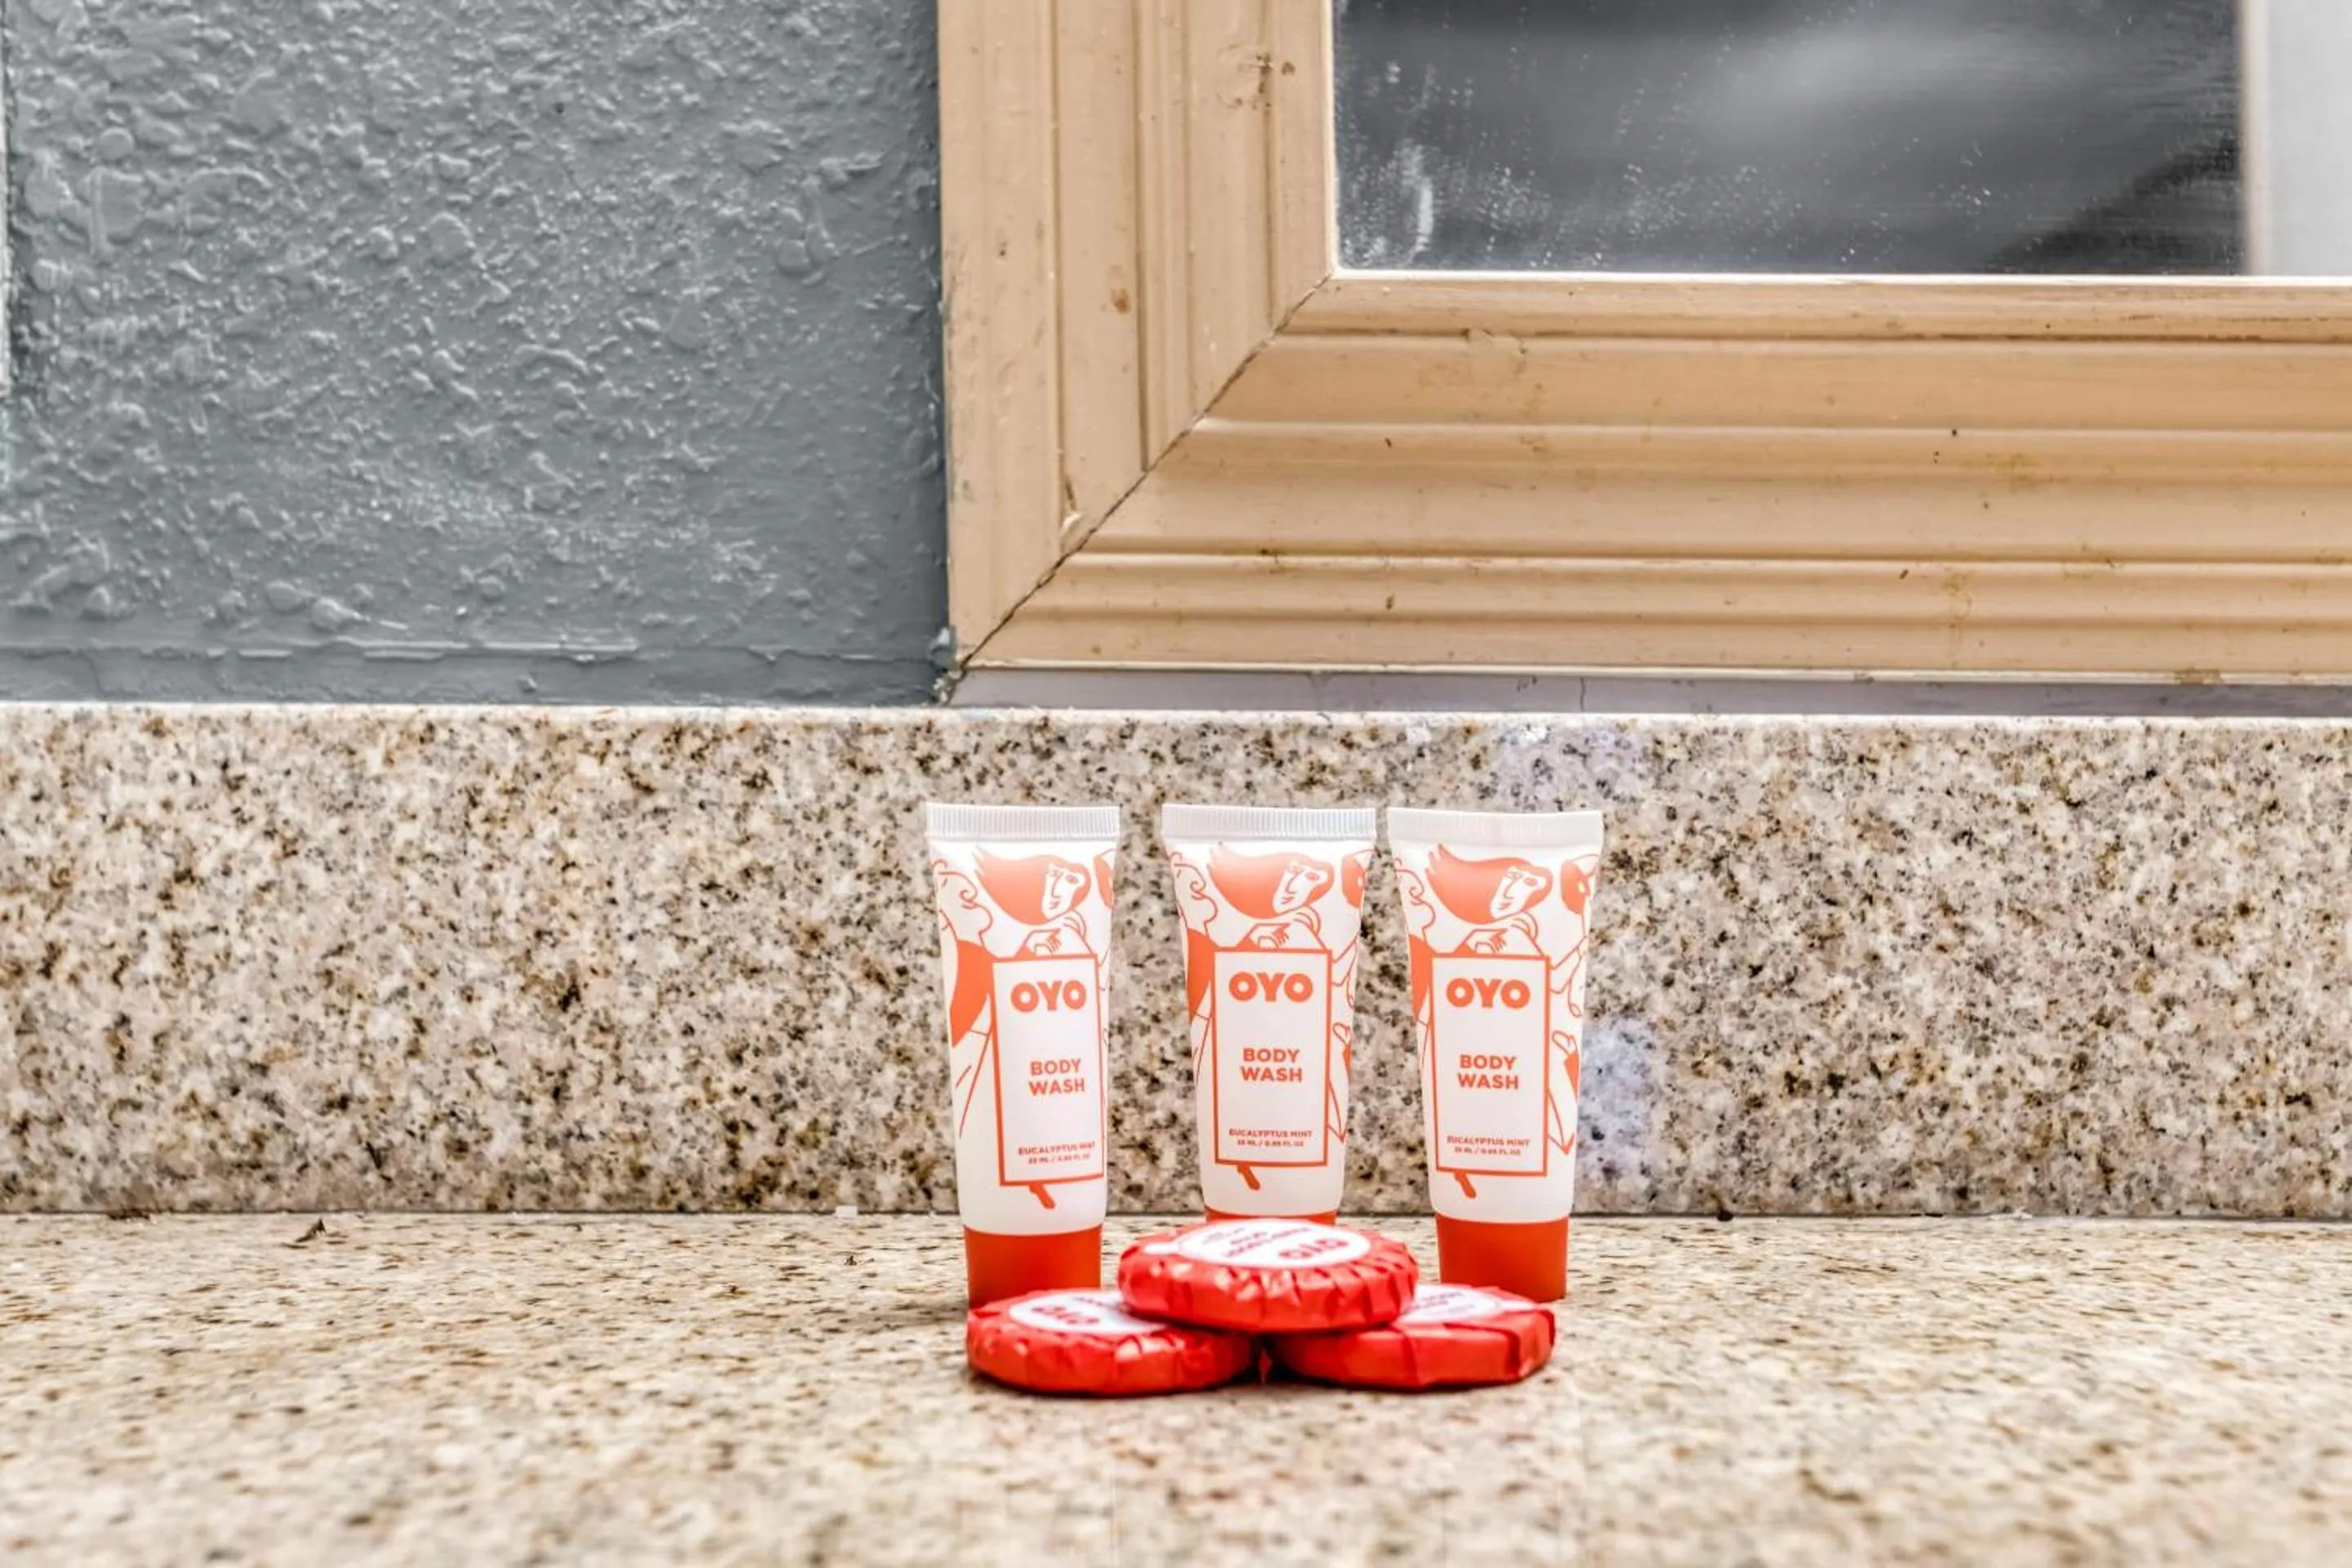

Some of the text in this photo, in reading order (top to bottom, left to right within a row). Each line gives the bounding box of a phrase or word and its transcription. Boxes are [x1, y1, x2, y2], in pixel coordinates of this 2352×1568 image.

[1009, 979, 1087, 1013] OYO
[1227, 970, 1314, 1005] OYO
[1445, 976, 1532, 1012] OYO
[1241, 1047, 1300, 1063] BODY
[1459, 1054, 1517, 1071] BODY
[1029, 1058, 1081, 1076] BODY
[1239, 1067, 1303, 1083] WASH
[1027, 1078, 1085, 1096] WASH
[1456, 1072, 1520, 1090] WASH
[1228, 1129, 1312, 1138] EUCALYPTUS MINT
[1446, 1135, 1530, 1147] EUCALYPTUS MINT
[1018, 1144, 1077, 1155] EUCALYPTUS
